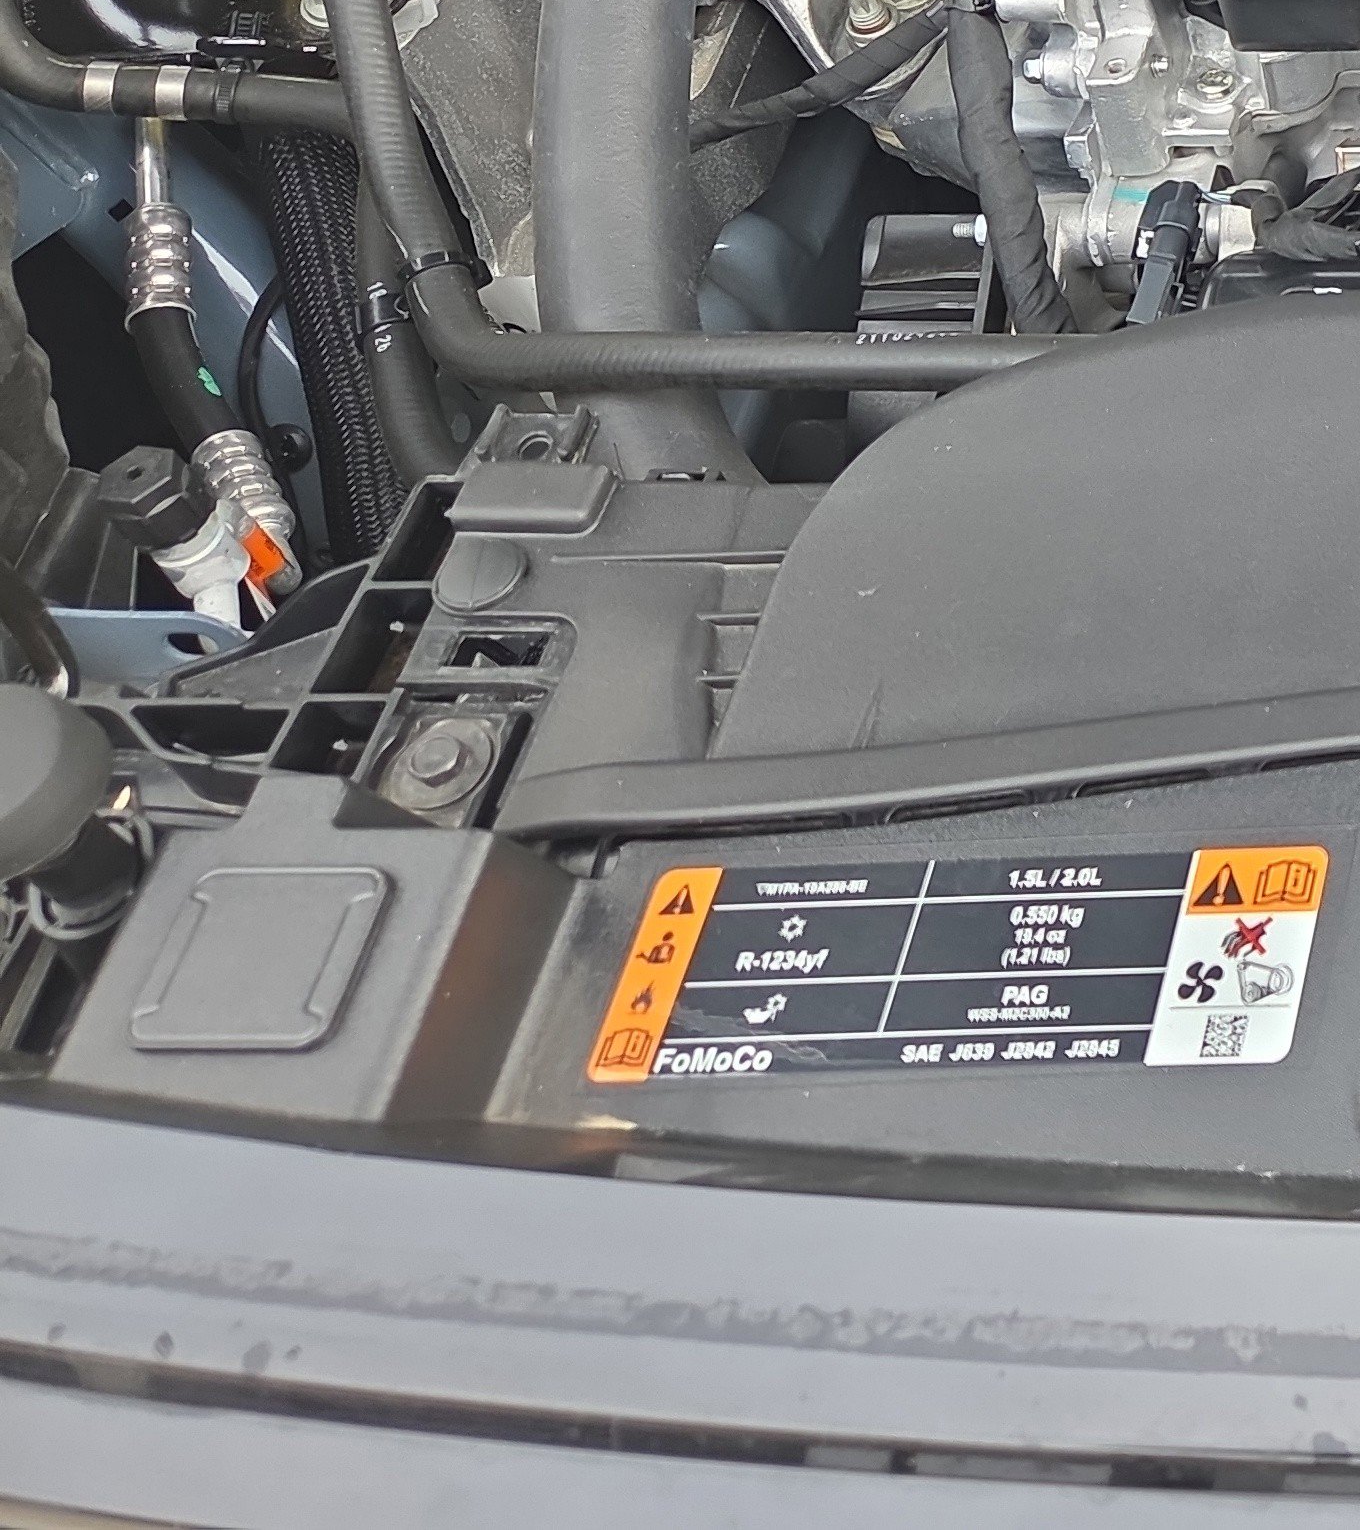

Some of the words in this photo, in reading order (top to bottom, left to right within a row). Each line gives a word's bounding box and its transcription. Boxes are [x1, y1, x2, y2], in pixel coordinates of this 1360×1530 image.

[1009, 869, 1047, 889] 1.5L
[1060, 867, 1102, 888] 2.0L
[1010, 904, 1059, 925] 0.550
[1059, 904, 1085, 928] kg
[1046, 929, 1068, 944] oz
[734, 949, 830, 974] R-1234yf
[1000, 947, 1039, 969] (1.21
[1040, 946, 1071, 968] lbs)
[1001, 984, 1050, 1006] PAG
[653, 1045, 773, 1073] FoMoCo
[900, 1042, 945, 1064] SAE
